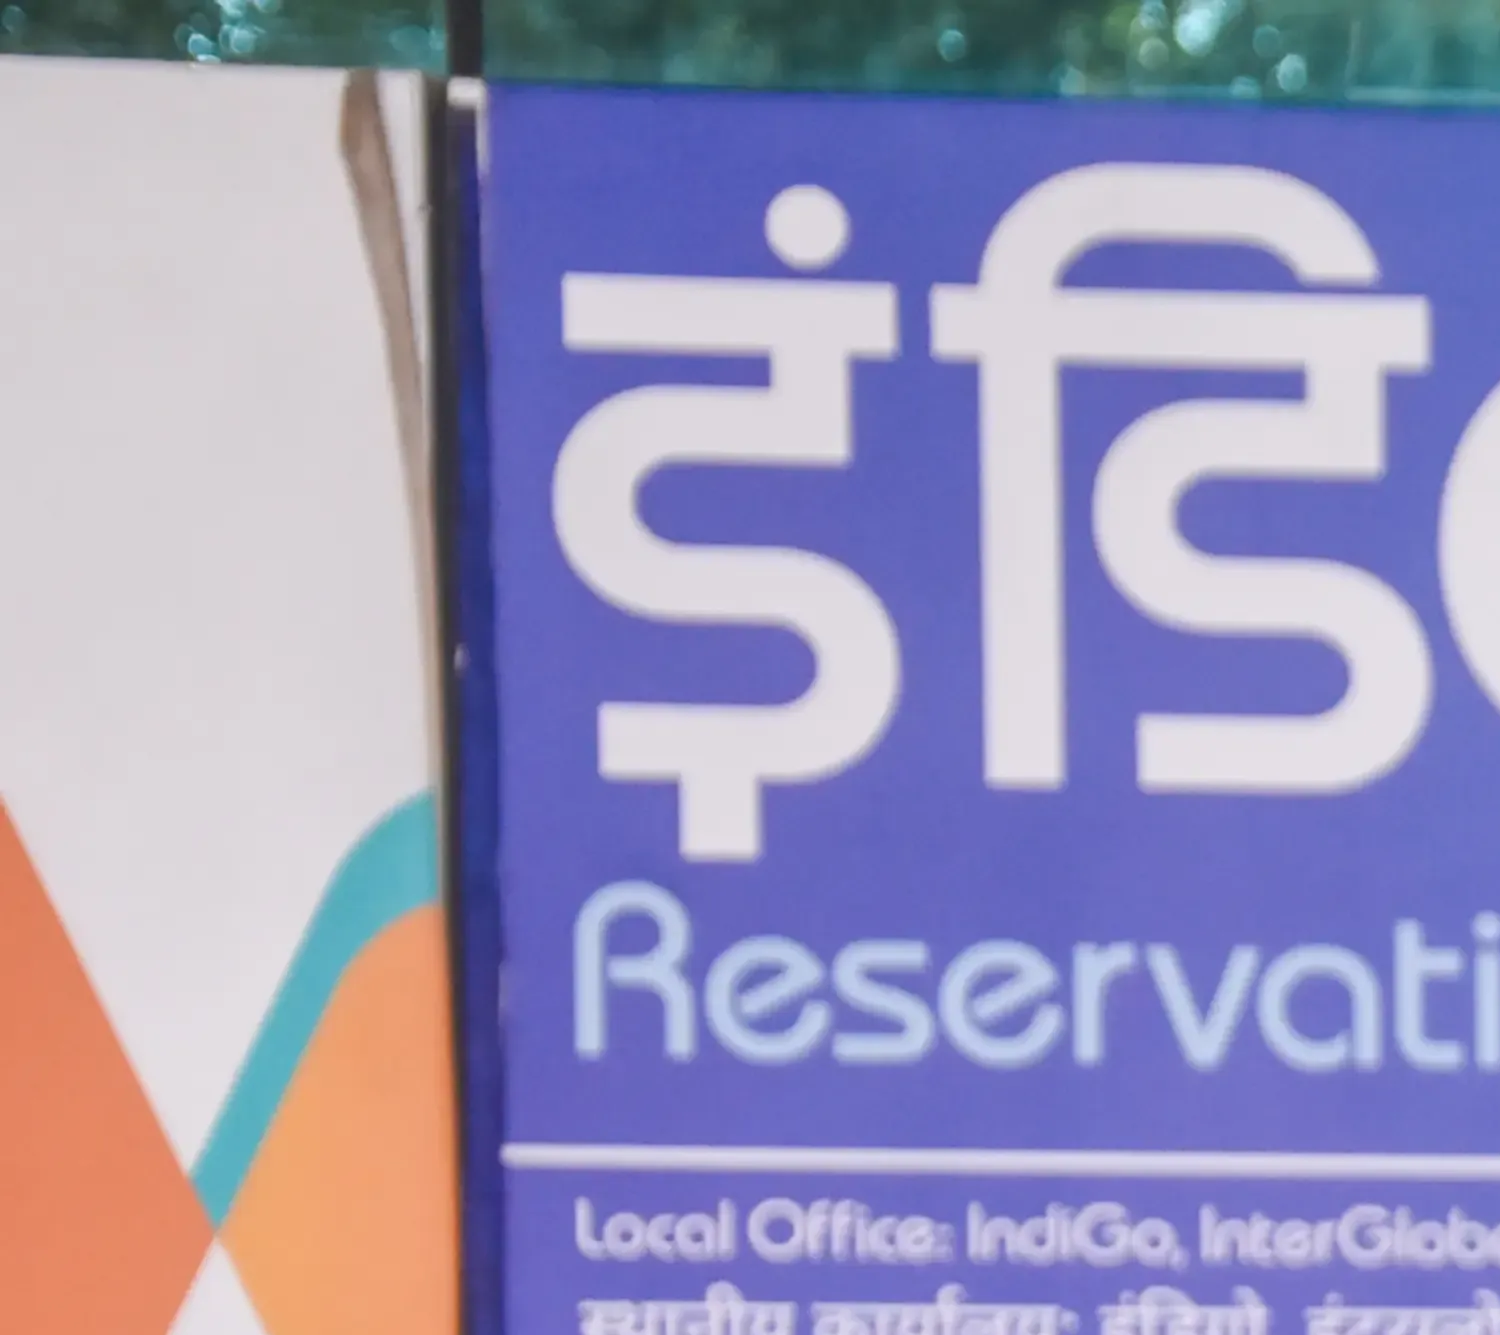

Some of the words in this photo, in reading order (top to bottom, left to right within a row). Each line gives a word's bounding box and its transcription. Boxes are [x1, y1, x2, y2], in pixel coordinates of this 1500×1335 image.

[574, 1196, 738, 1262] Local
[747, 1197, 954, 1265] Office:
[967, 1201, 1189, 1271] IndiGo,
